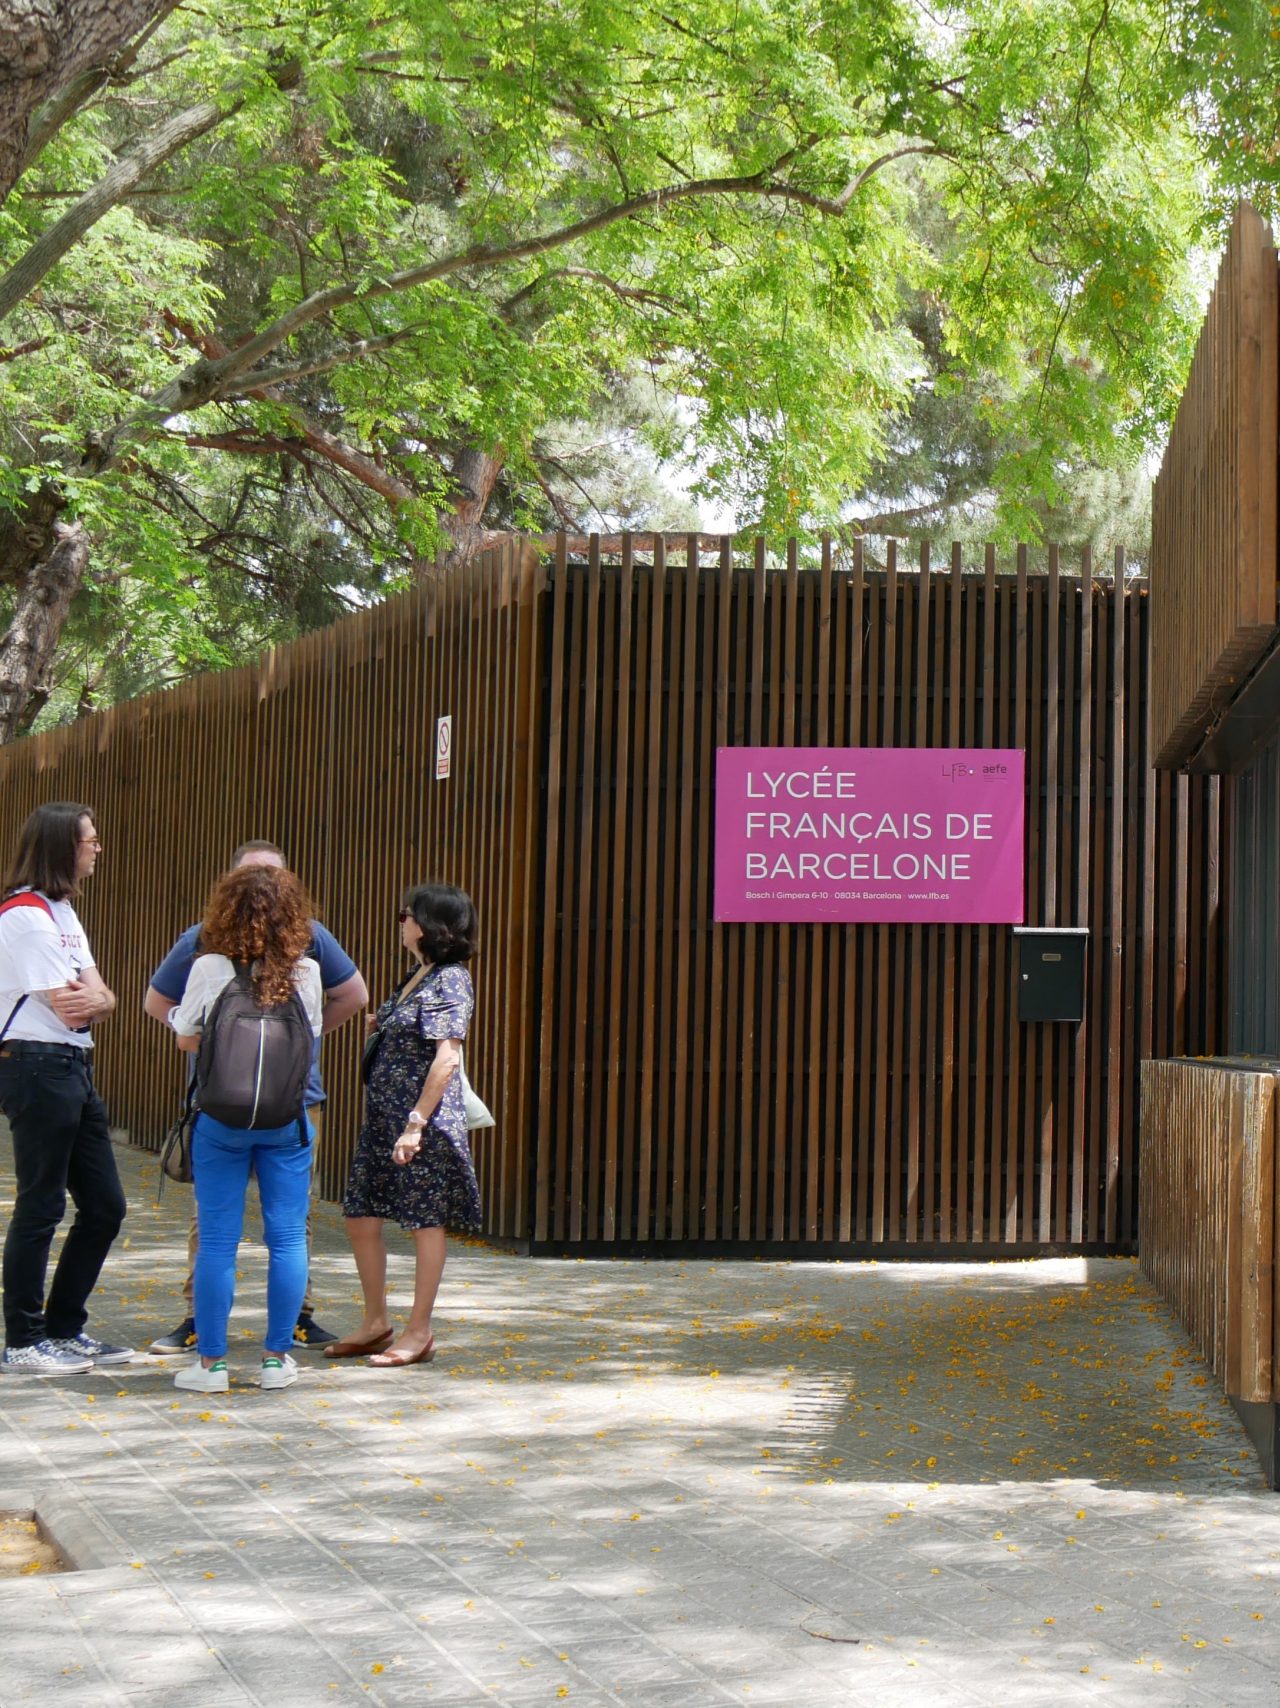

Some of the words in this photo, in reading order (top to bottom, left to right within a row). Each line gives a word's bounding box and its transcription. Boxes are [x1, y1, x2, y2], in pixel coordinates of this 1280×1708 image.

[746, 765, 856, 798] LYCÉE
[982, 763, 1007, 774] aefe
[746, 812, 932, 844] FRANÇAIS
[946, 813, 993, 840] DE
[746, 853, 971, 880] BARCELONE
[746, 891, 770, 899] Bosch
[777, 891, 810, 901] Gimpera
[863, 892, 902, 900] Barcelona
